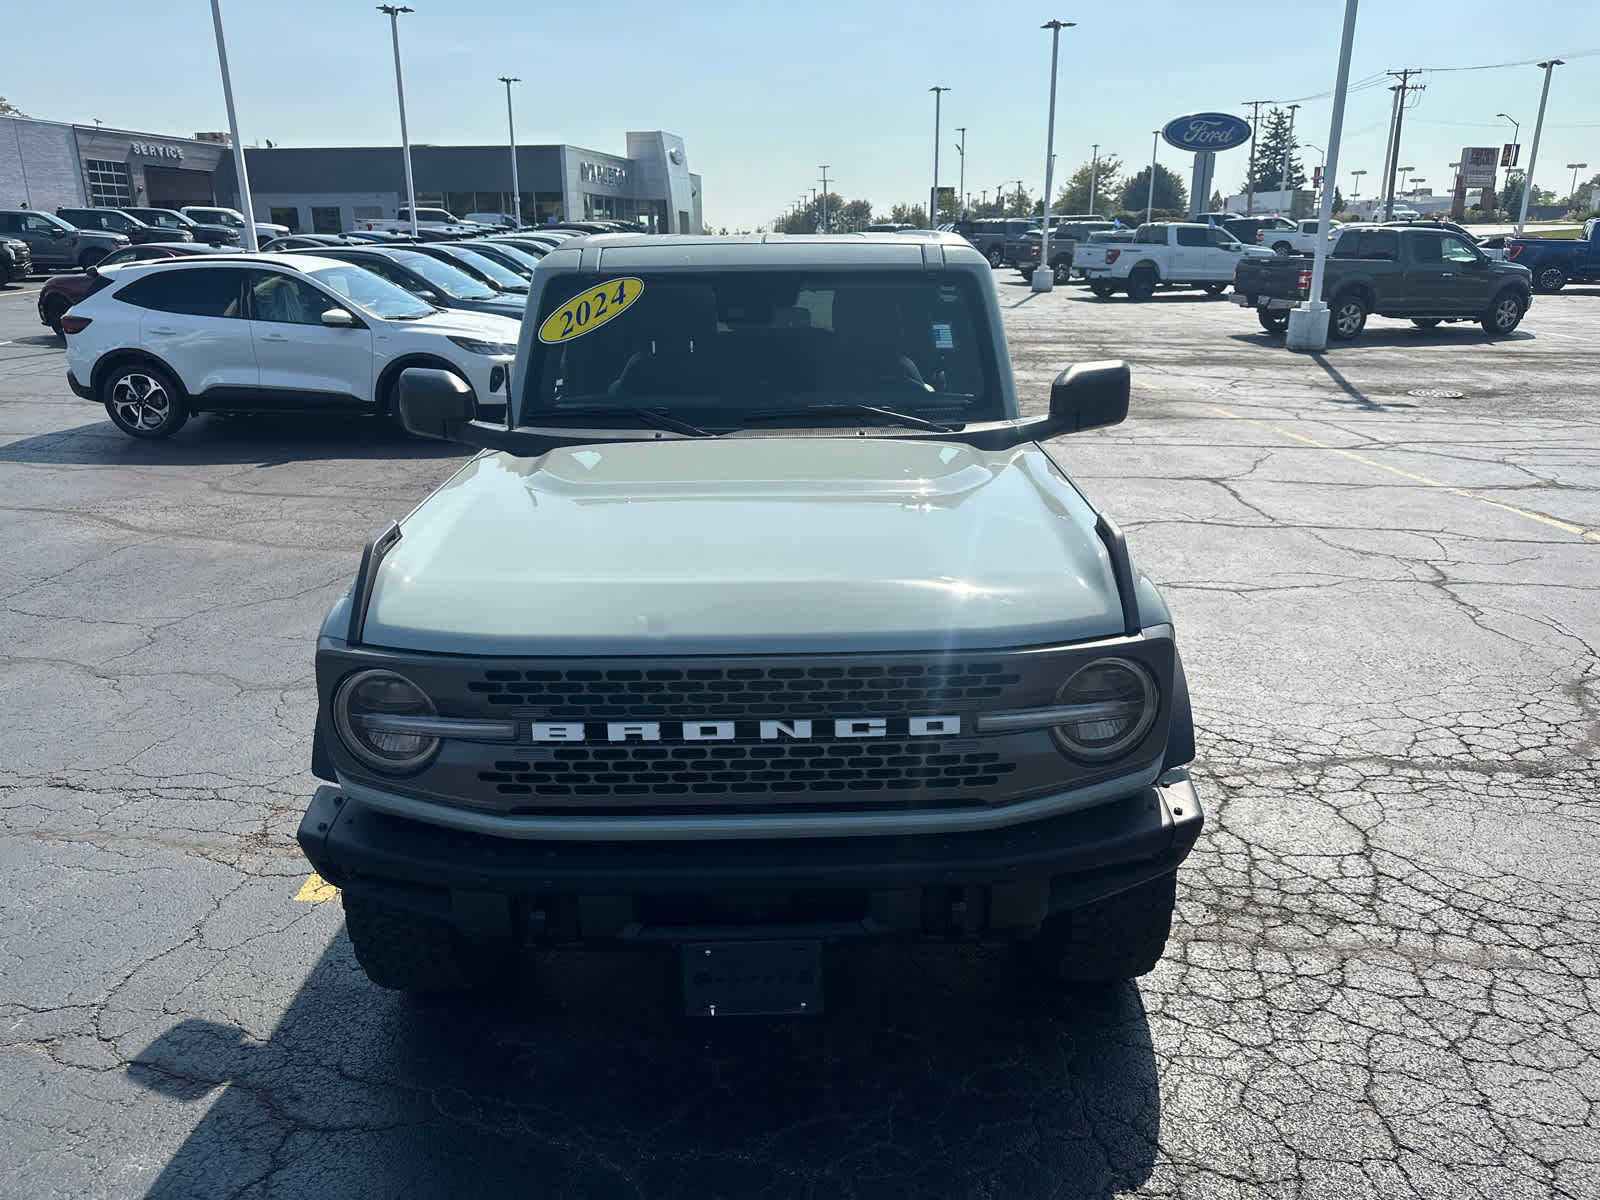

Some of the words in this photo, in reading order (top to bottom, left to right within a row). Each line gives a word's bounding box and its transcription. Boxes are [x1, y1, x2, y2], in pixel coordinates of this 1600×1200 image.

[1183, 120, 1235, 144] Ford
[132, 142, 184, 160] SERVICE
[560, 280, 626, 338] 2024
[531, 715, 961, 742] BRONCO
